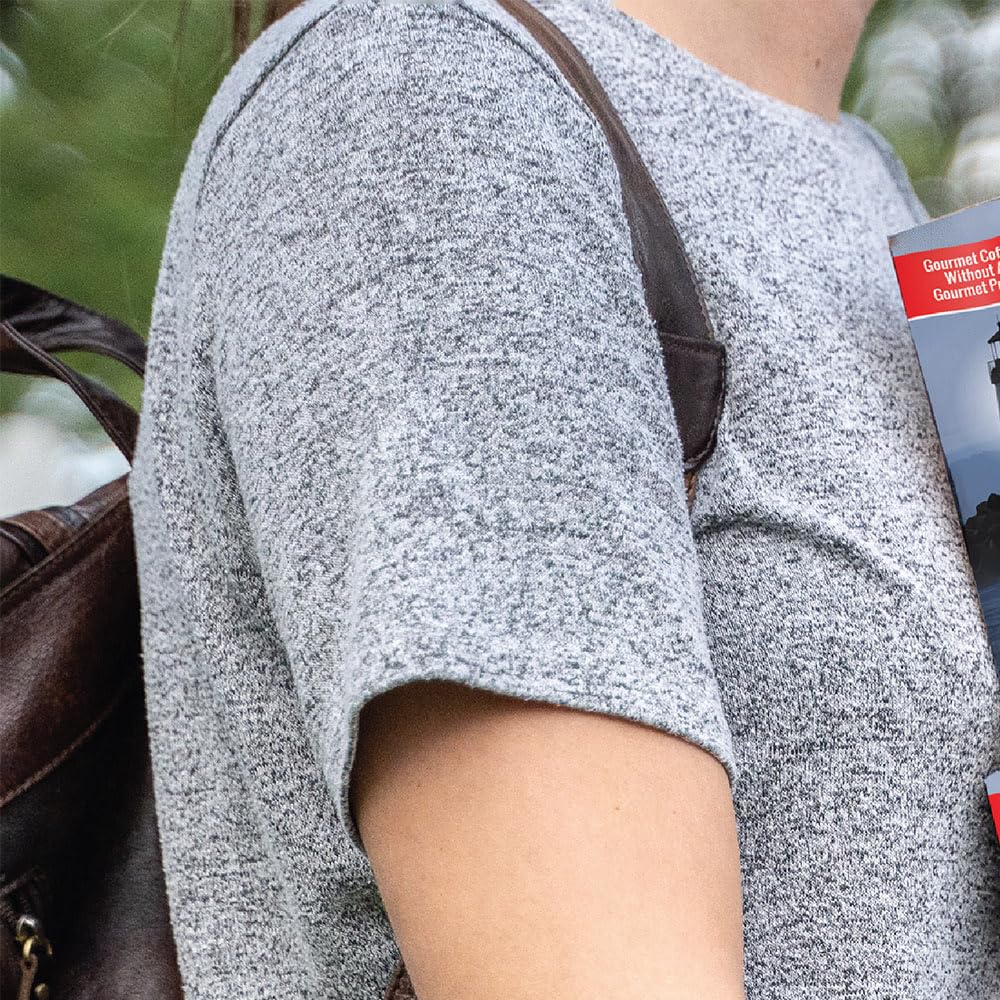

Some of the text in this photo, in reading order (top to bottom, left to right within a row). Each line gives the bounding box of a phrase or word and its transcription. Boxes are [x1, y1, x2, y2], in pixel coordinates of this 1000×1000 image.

[923, 254, 978, 273] Gourmet
[944, 264, 995, 285] Without
[933, 282, 988, 301] Gourmet
